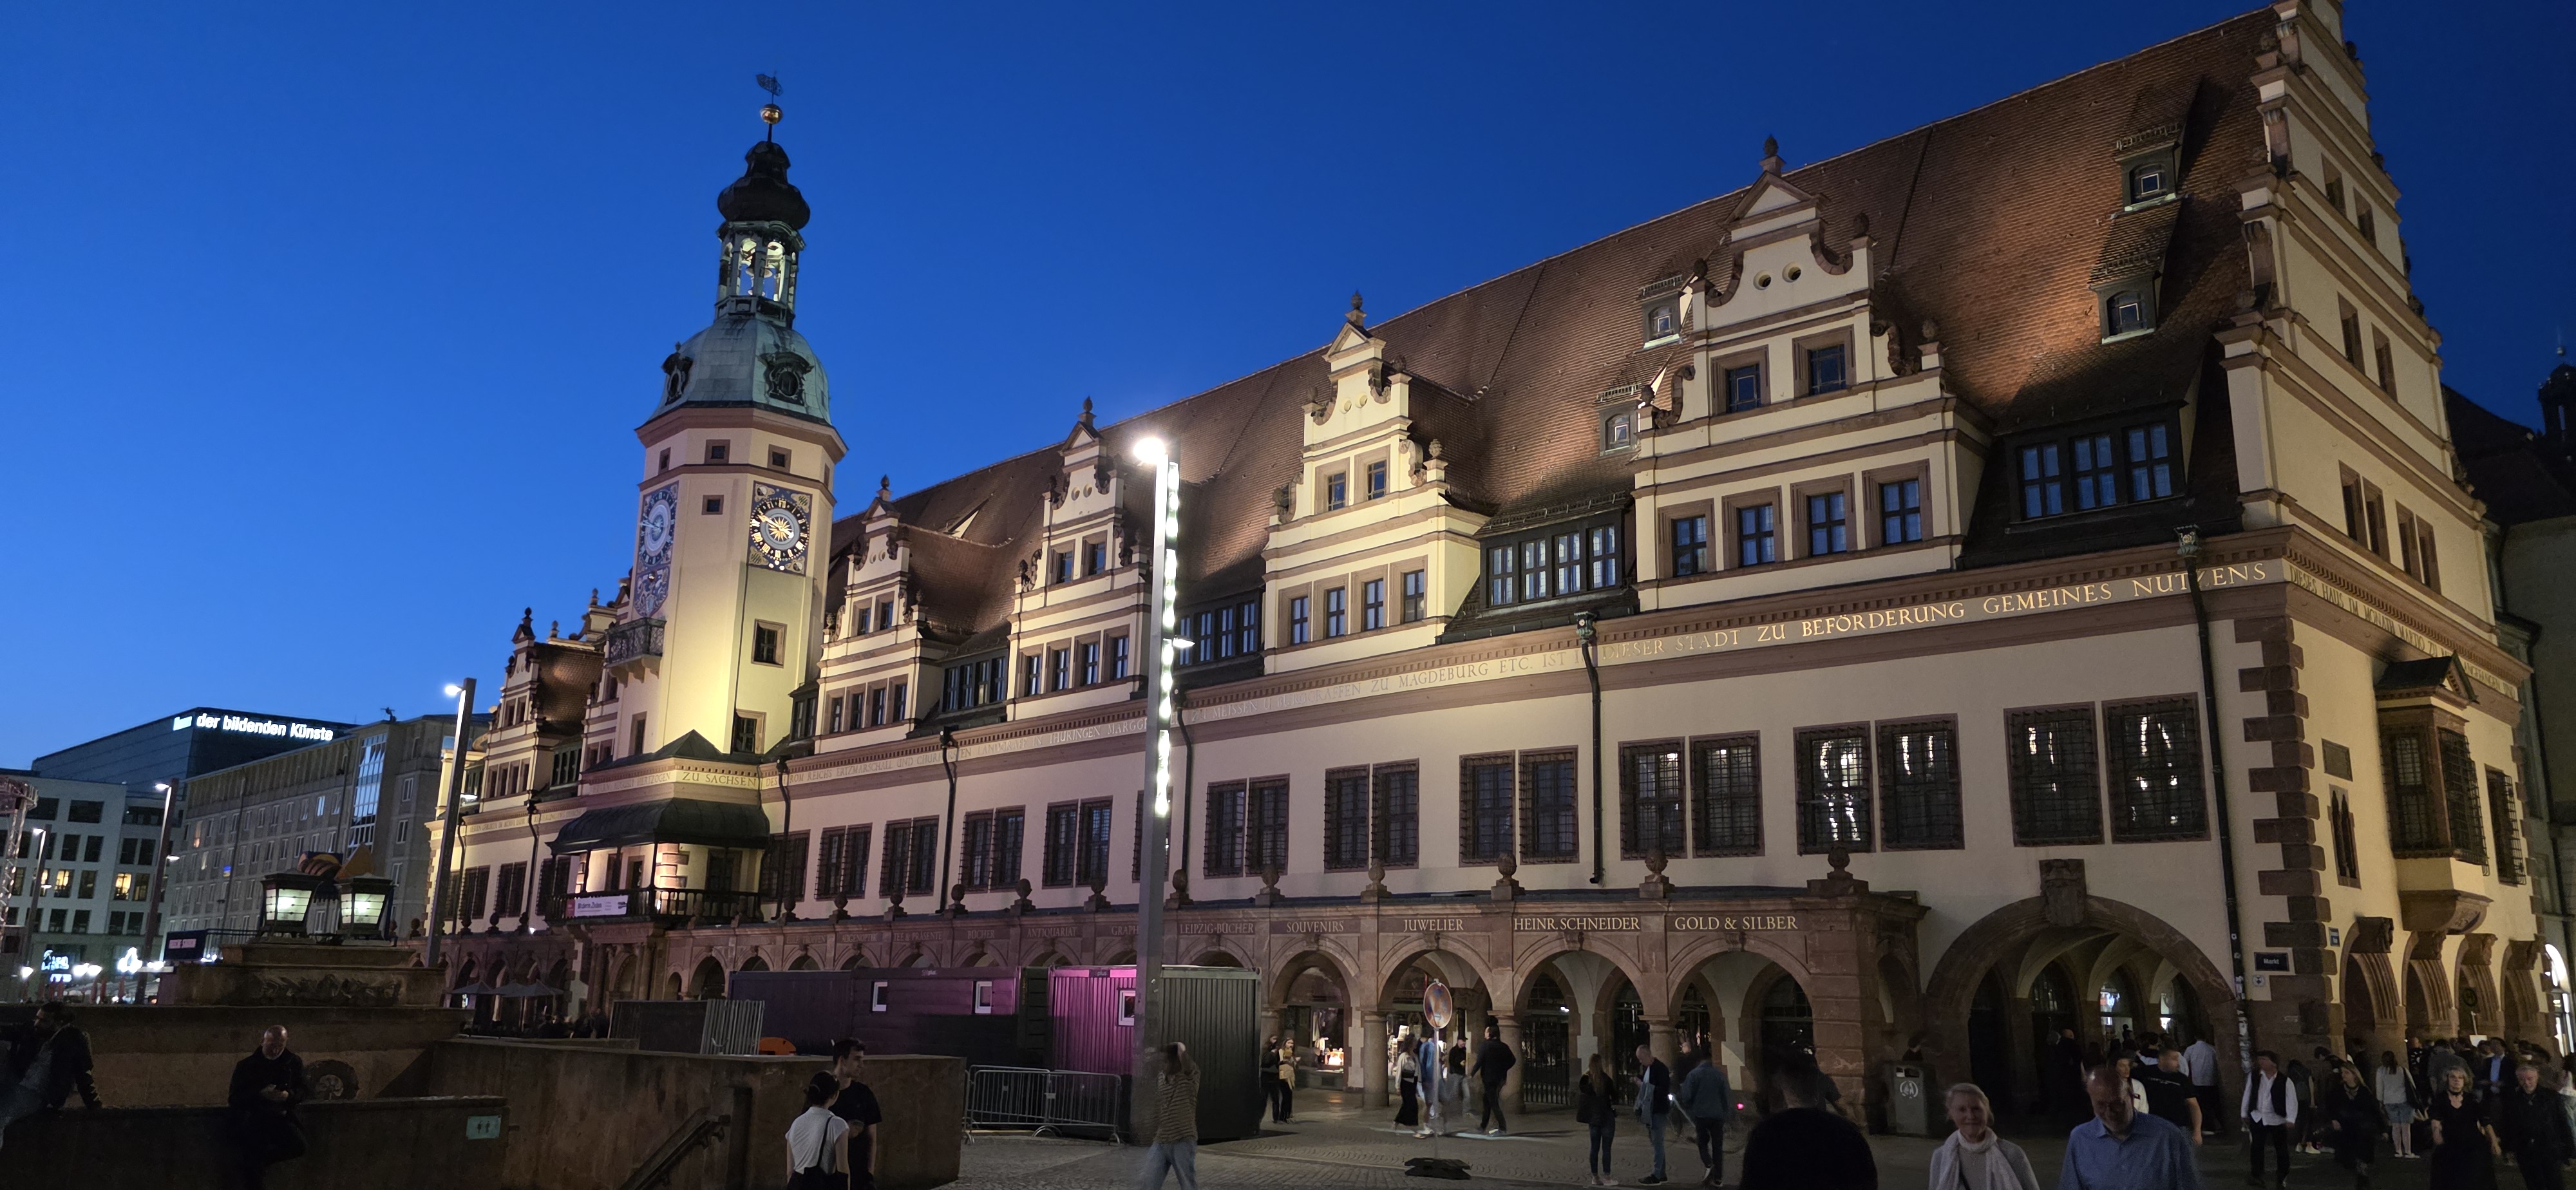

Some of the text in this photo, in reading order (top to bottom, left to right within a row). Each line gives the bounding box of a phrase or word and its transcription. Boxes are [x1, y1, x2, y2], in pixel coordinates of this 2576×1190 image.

[2289, 565, 2317, 594] DIESES
[2322, 583, 2344, 608] HAUS
[766, 777, 777, 787] DES
[808, 769, 832, 781] REICHS
[896, 757, 913, 768] UND
[917, 747, 972, 766] CHURFRSTEN
[1107, 717, 1148, 734] MARGG
[1213, 700, 1258, 719] MEISSEN
[1371, 677, 1390, 693] ZU
[1399, 663, 1489, 688] MAGDEBURG
[1499, 656, 1533, 674] ETC.
[1542, 651, 1567, 668] IST
[1602, 639, 1665, 660] DIESER
[1675, 629, 1741, 652] STADT
[1757, 623, 1786, 642] ZU
[1802, 602, 1965, 637] BEFÖRDERUNG
[1983, 583, 2112, 614] GEMEINES
[196, 713, 221, 729] der
[223, 715, 287, 736] bildenden
[290, 722, 334, 741] Künste
[682, 771, 757, 787] ZU SACHSEN
[1180, 921, 1254, 934] LEIPZIG-BÜCHER
[1286, 920, 1345, 933] SOUVENIRS
[1403, 918, 1464, 932] JUWELIER
[1674, 916, 1799, 930] GOLD & SILBER
[1027, 927, 1078, 938] ANTIQUARIAT
[1111, 925, 1139, 936] GRAPH
